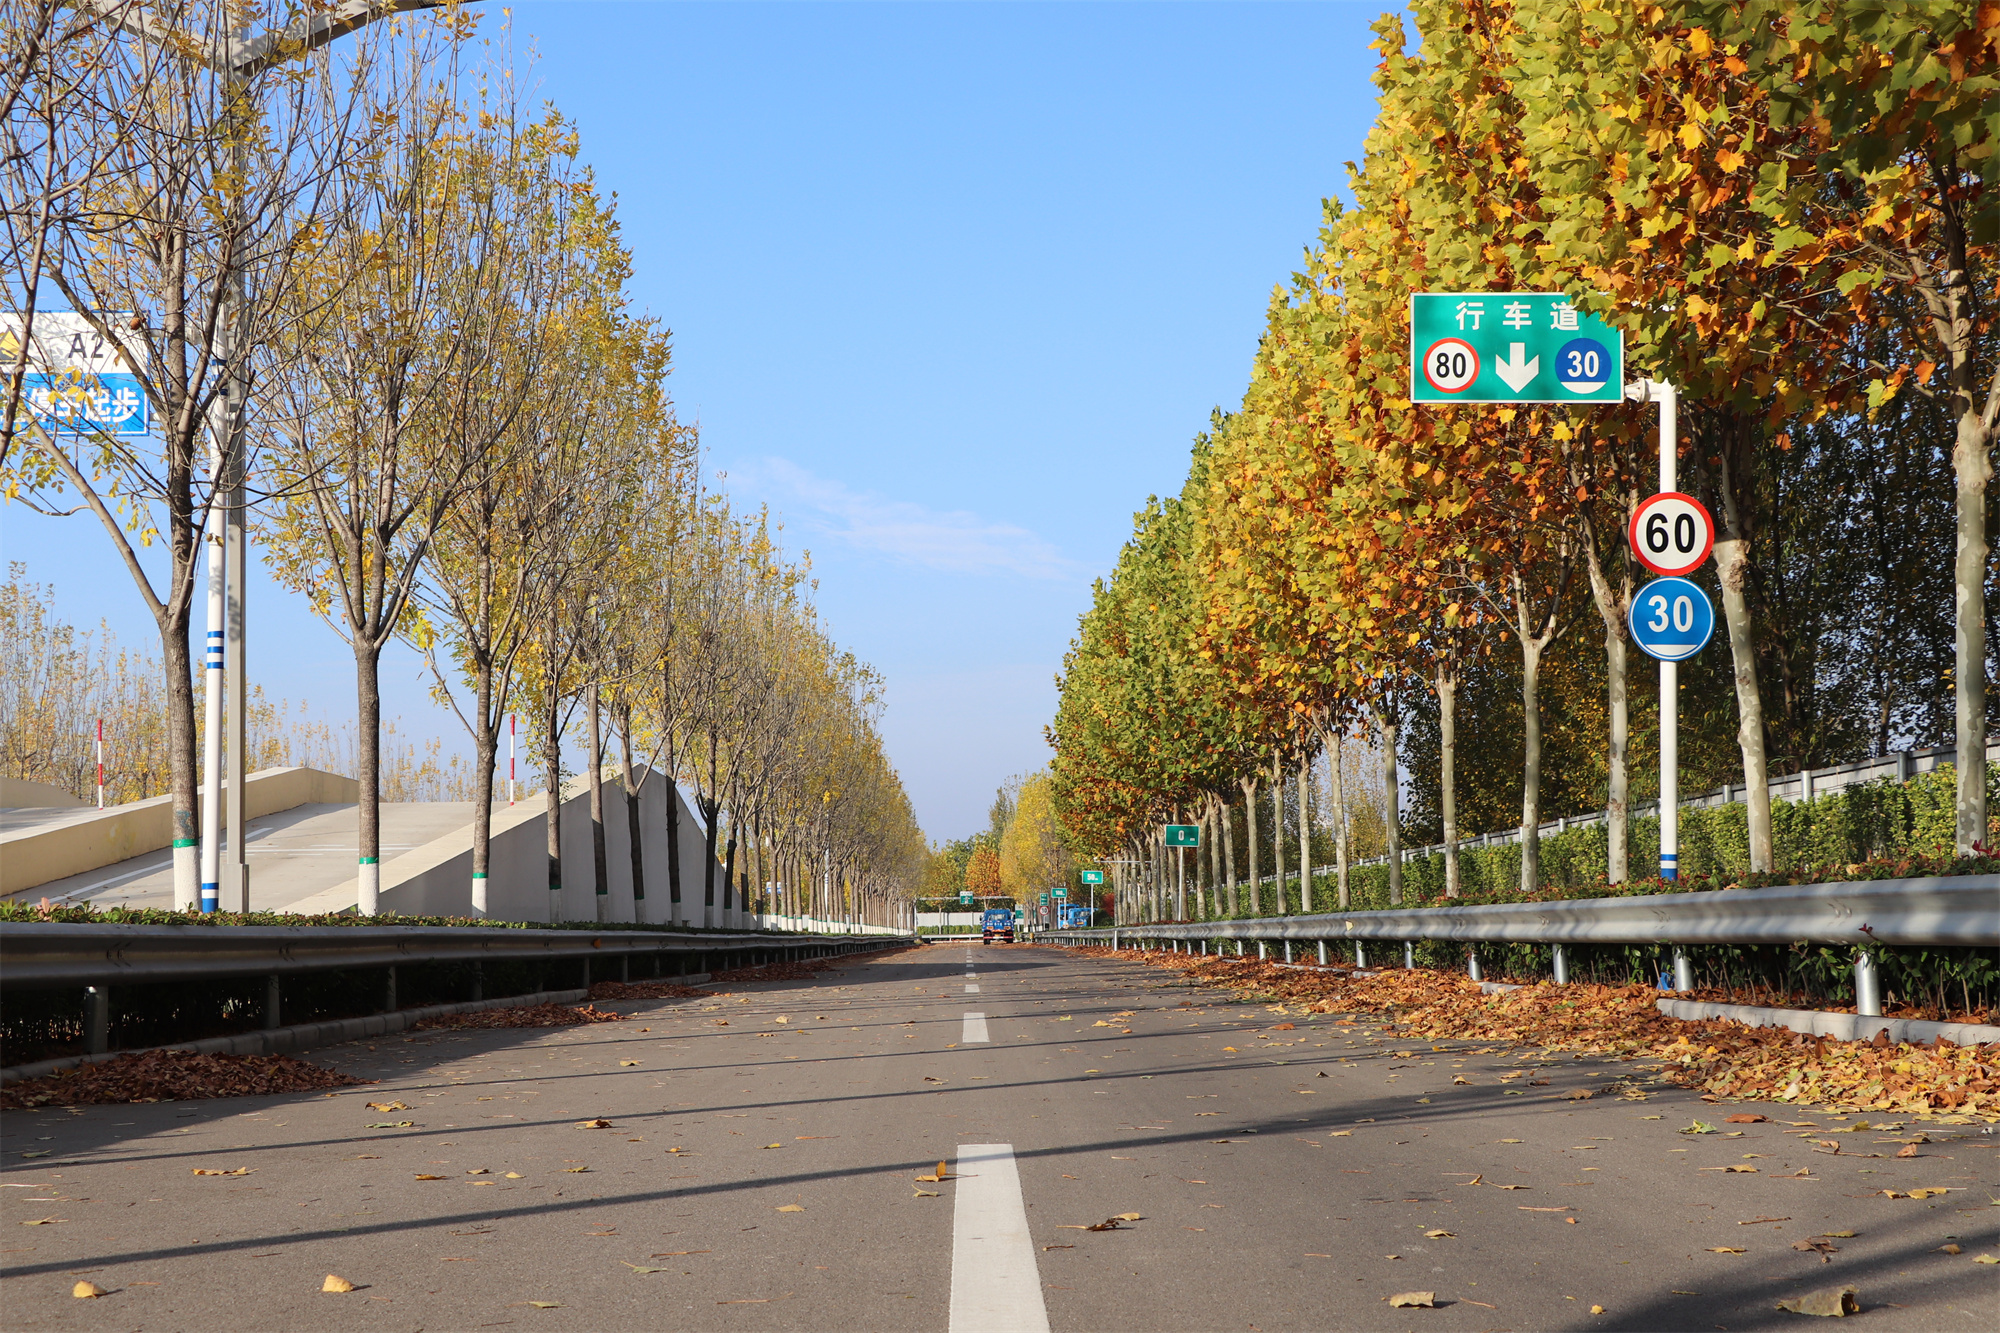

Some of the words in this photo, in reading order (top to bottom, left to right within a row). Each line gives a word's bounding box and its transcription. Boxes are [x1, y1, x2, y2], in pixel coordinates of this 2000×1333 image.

[1455, 301, 1580, 331] 行车道
[68, 333, 104, 358] A2
[1436, 352, 1467, 378] 80
[1567, 350, 1599, 378] 30
[1646, 513, 1695, 553] 60
[1648, 595, 1694, 633] 30
